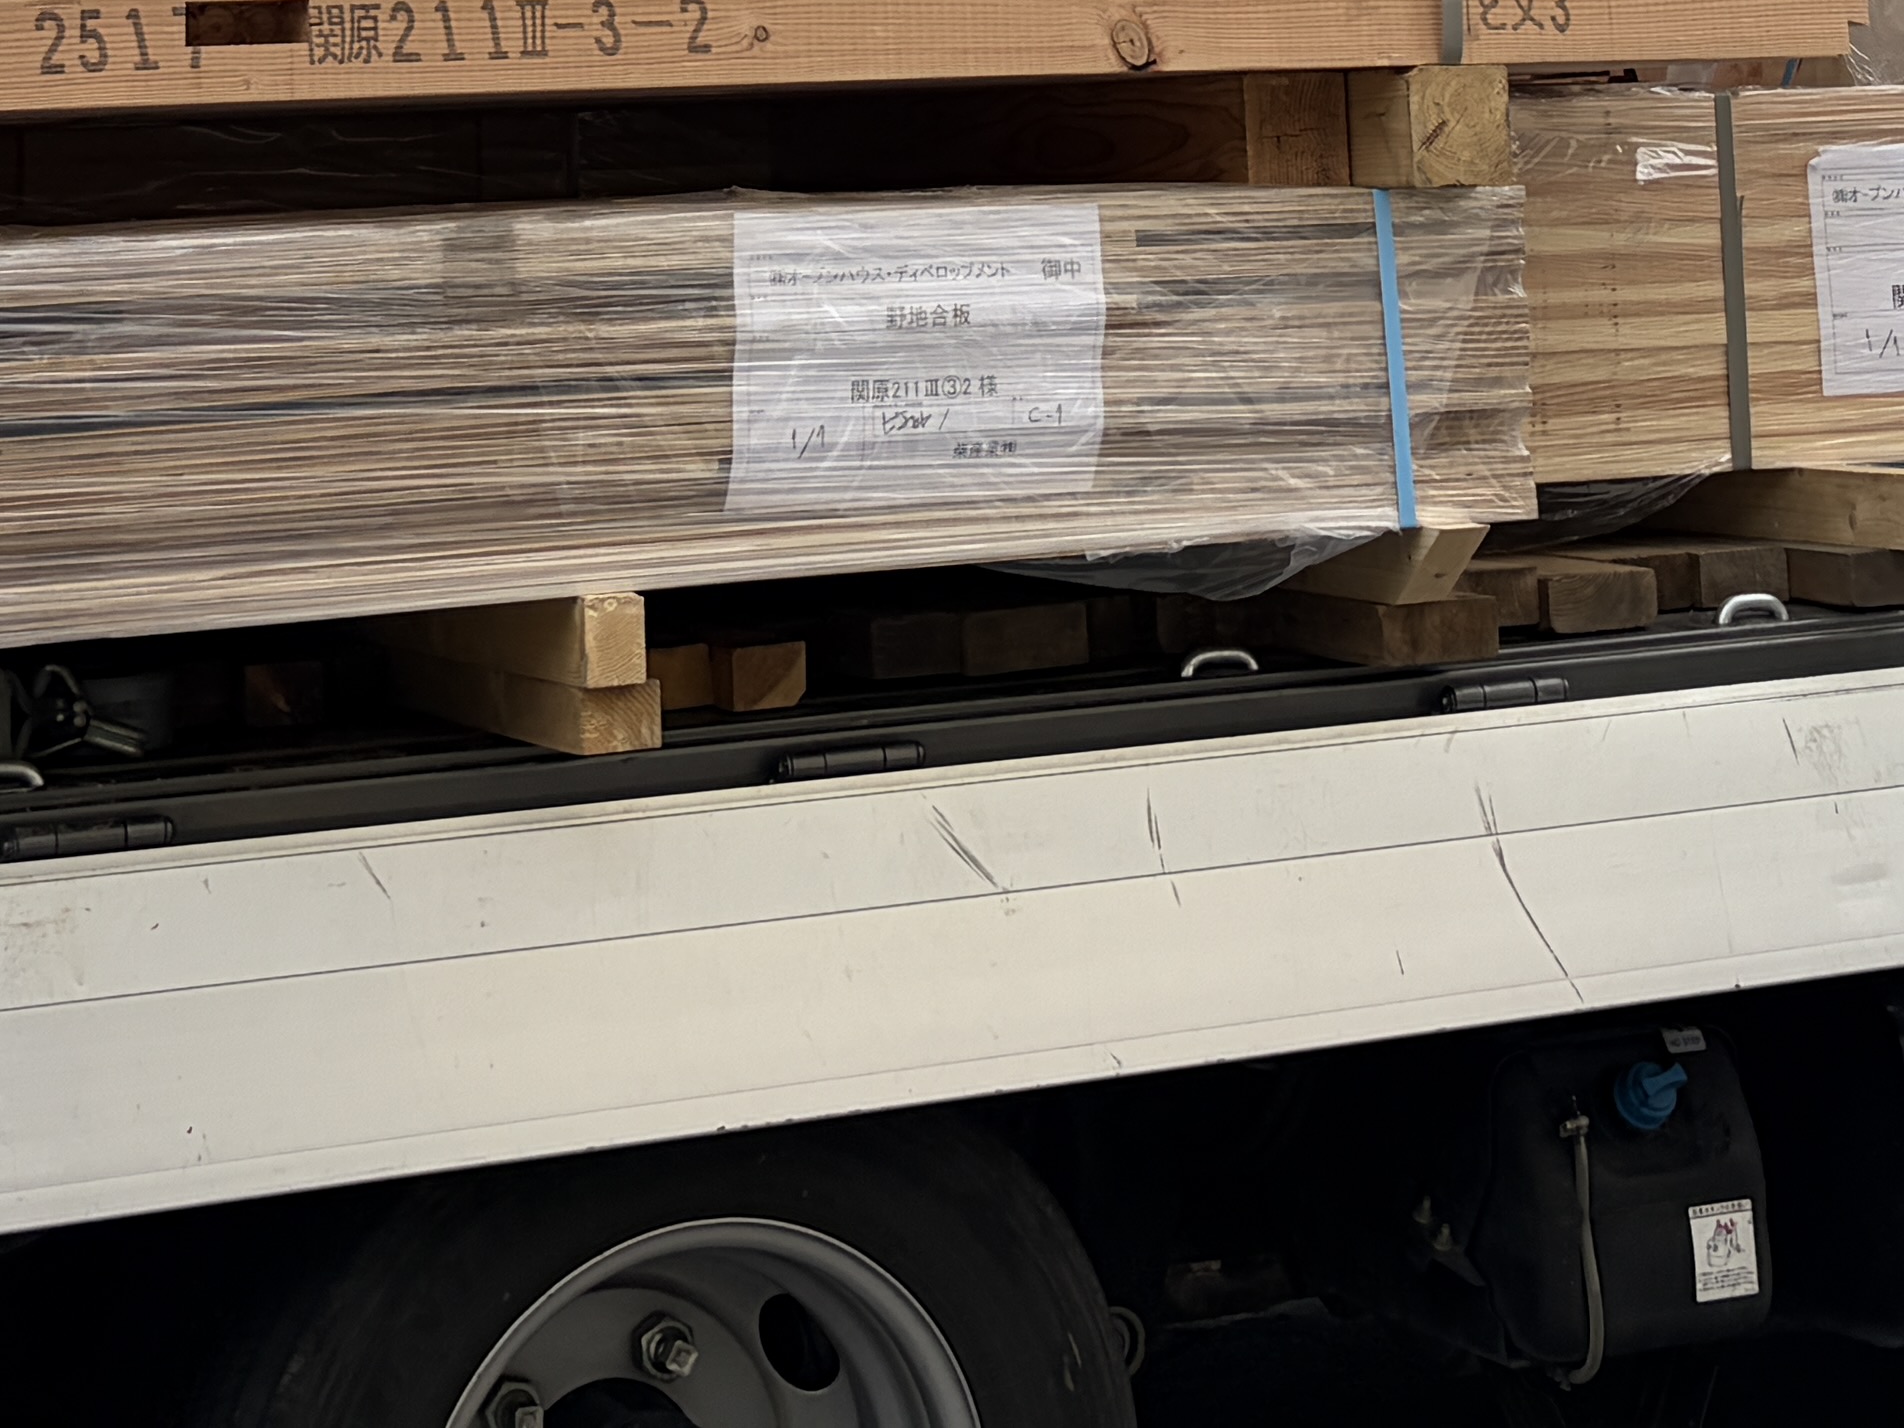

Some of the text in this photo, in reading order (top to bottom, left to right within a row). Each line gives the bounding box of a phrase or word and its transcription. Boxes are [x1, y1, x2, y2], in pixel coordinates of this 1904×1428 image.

[1041, 257, 1082, 280] 御中
[886, 302, 971, 329] 野地合板
